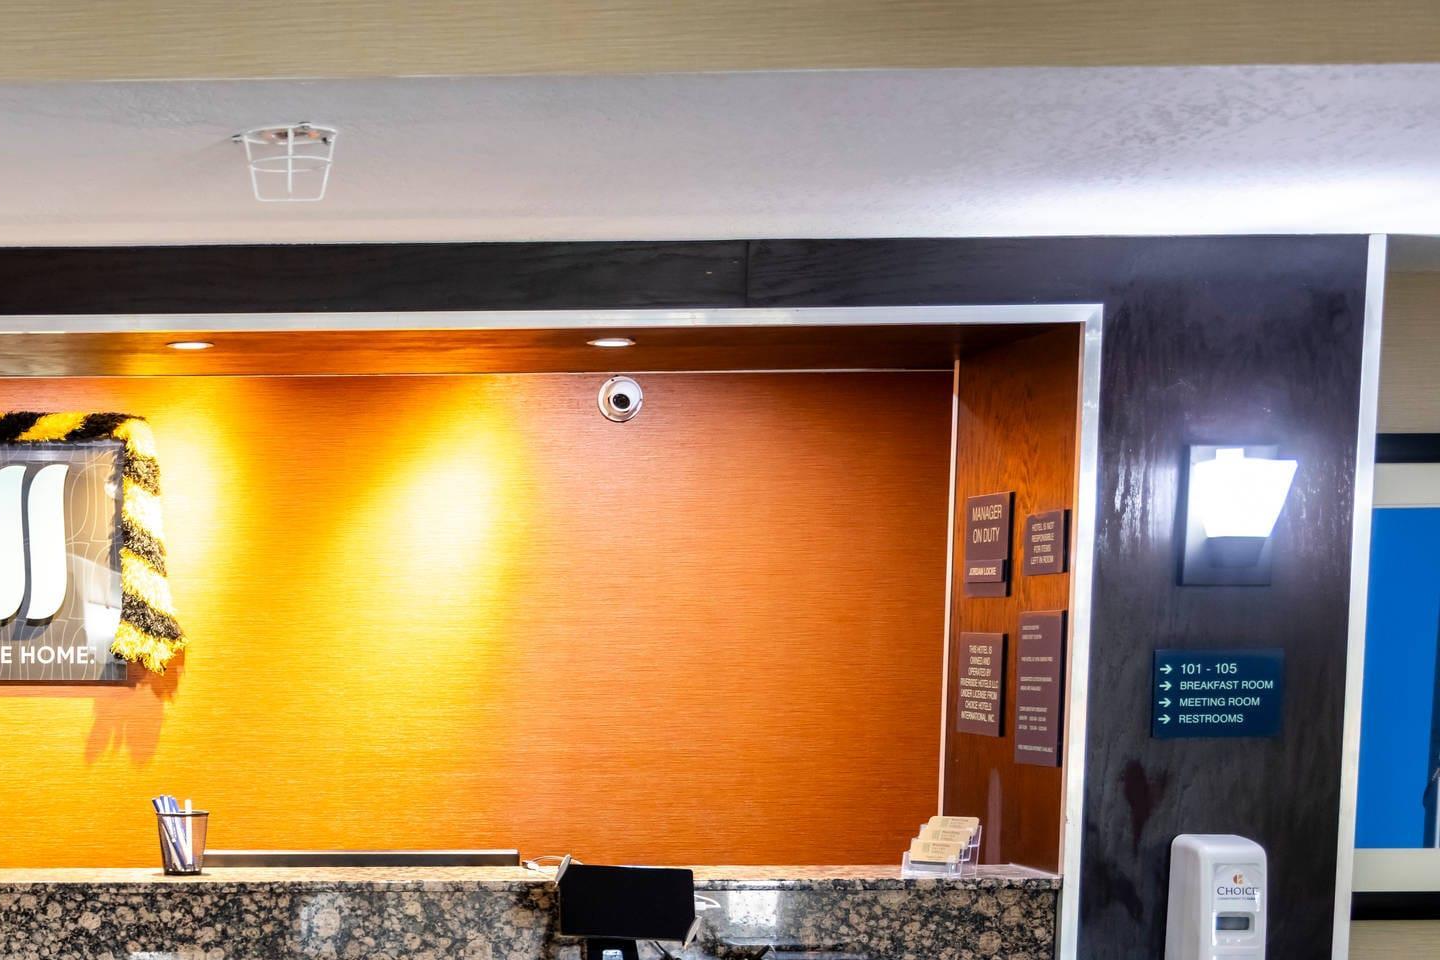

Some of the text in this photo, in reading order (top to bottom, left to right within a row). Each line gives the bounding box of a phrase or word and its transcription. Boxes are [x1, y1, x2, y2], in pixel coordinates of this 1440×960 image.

[972, 504, 1002, 521] MANAGER
[972, 527, 1000, 543] ON DUTY
[1181, 663, 1201, 674] 101
[1215, 663, 1237, 674] 105
[1180, 680, 1274, 690] BREAKFAST ROOM
[1179, 697, 1260, 707] MEETING ROOM
[1179, 714, 1244, 723] RESTROOMS
[1217, 886, 1259, 896] CHOICE
